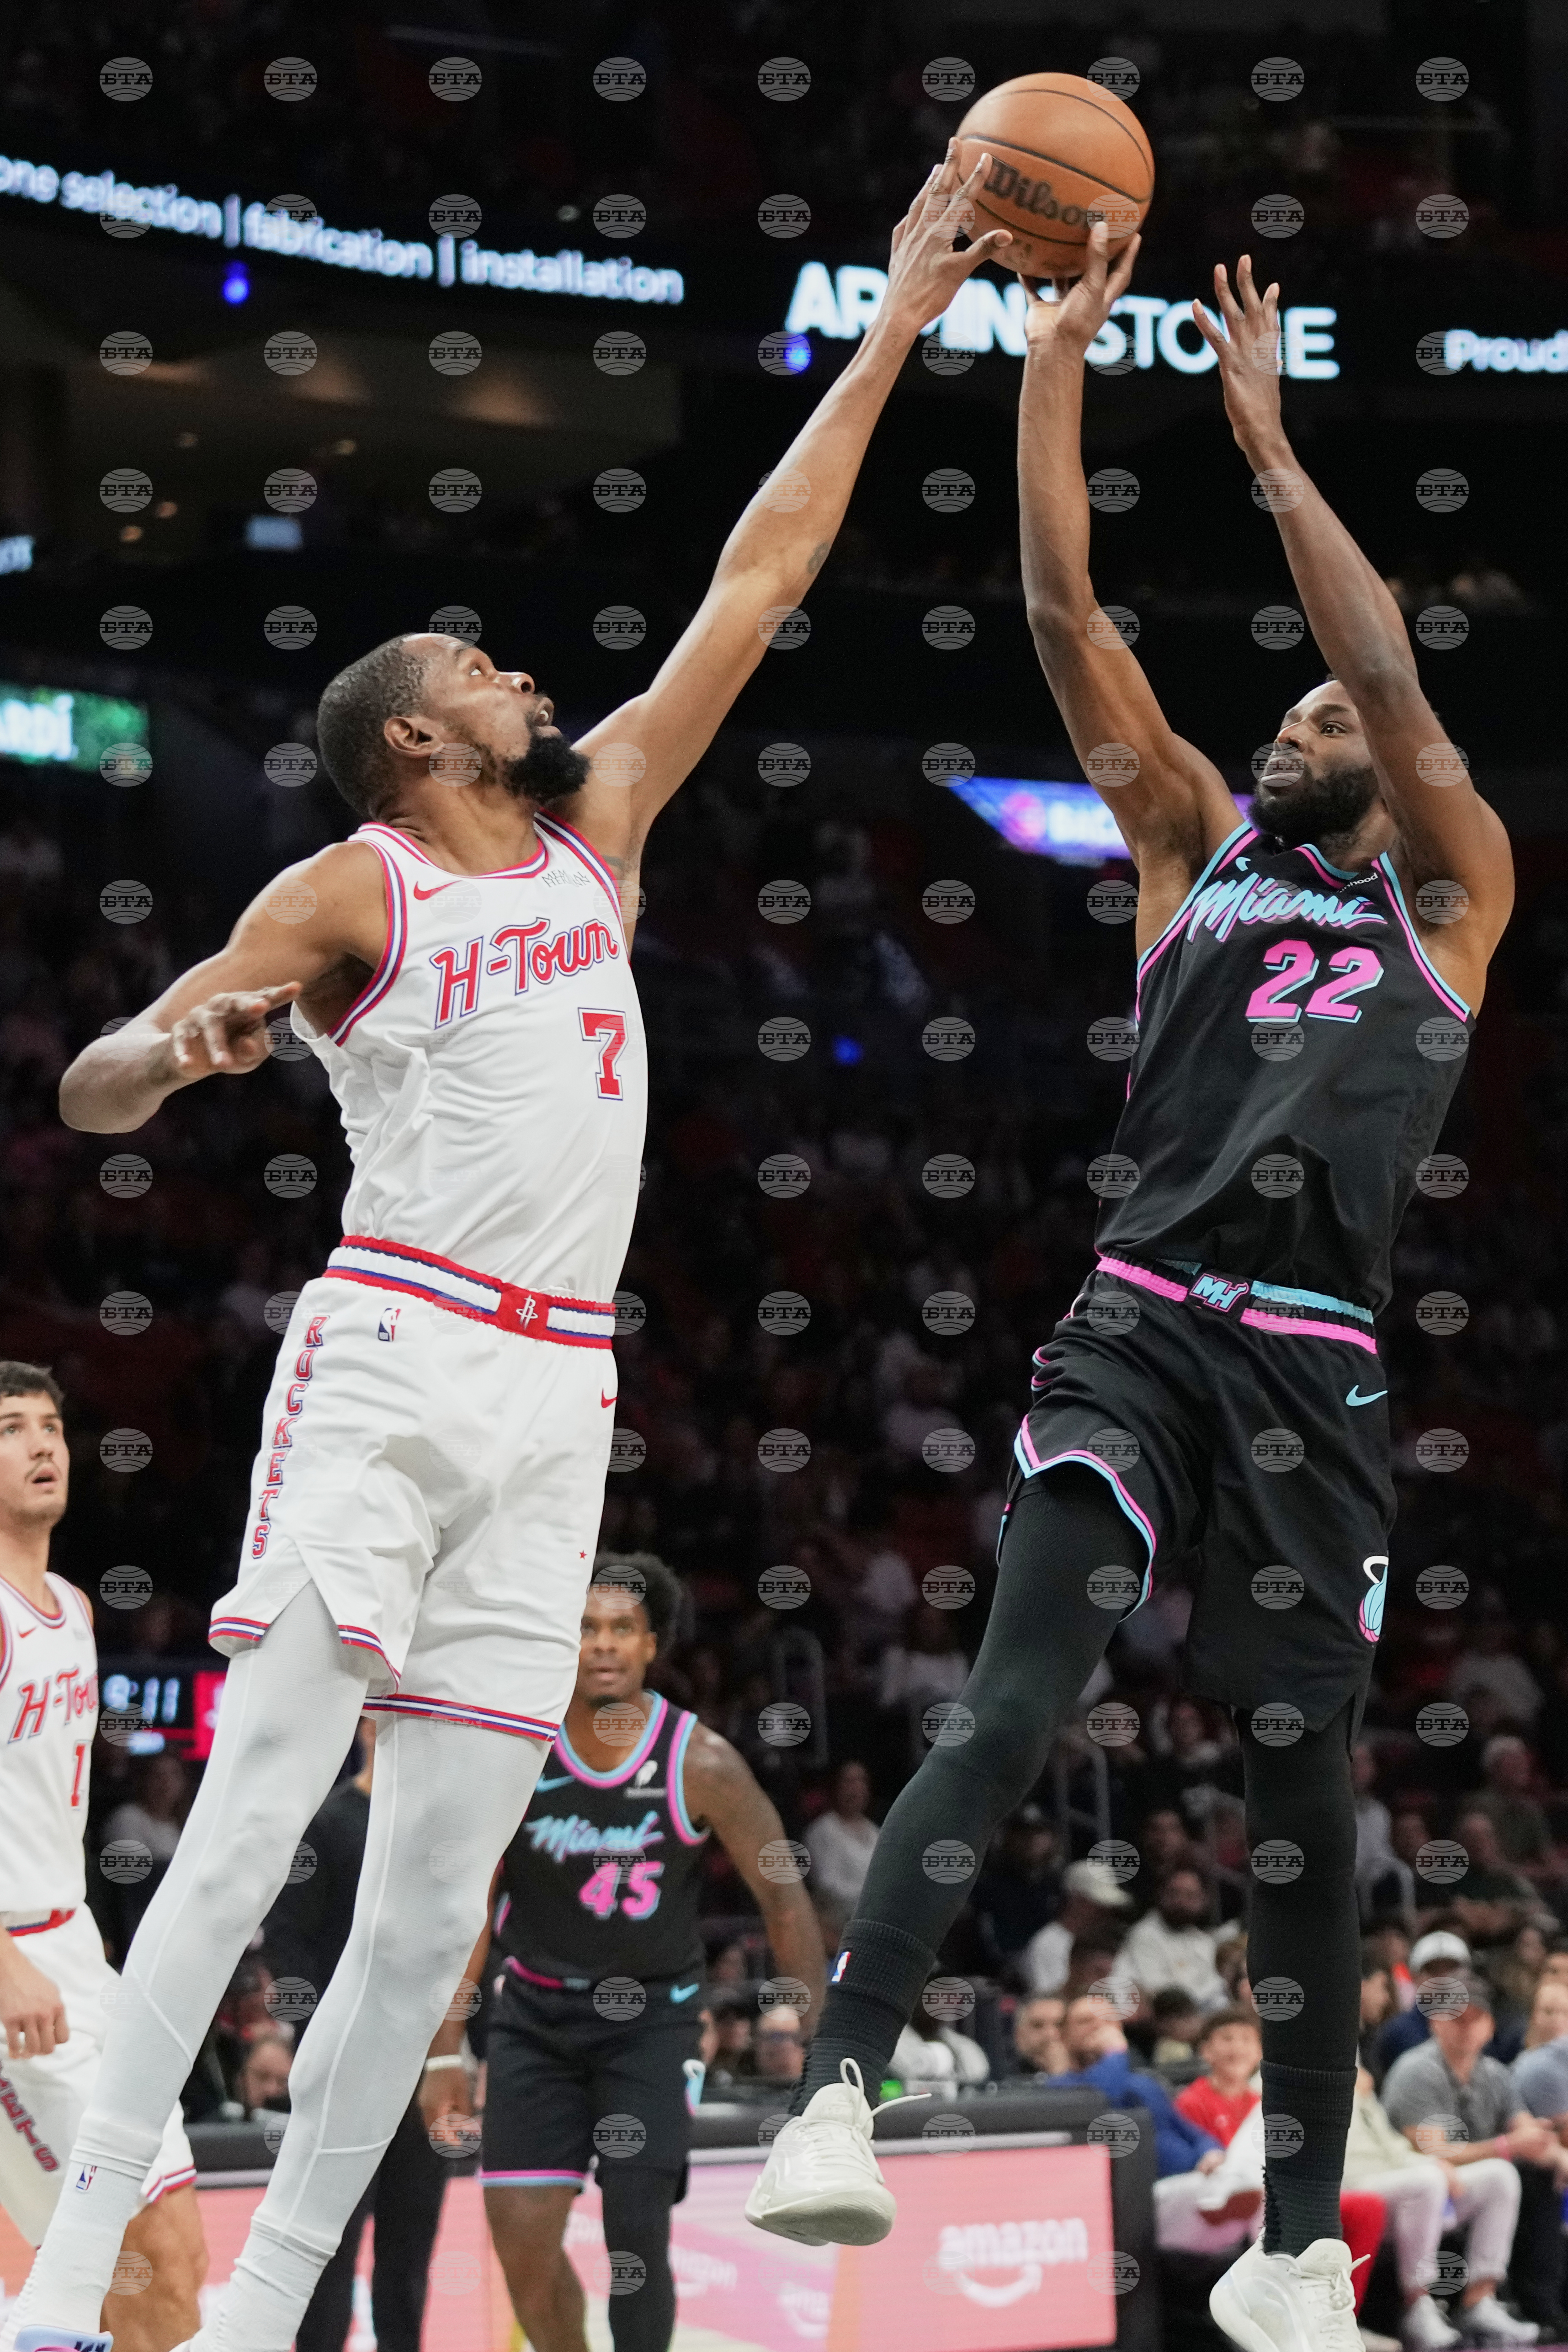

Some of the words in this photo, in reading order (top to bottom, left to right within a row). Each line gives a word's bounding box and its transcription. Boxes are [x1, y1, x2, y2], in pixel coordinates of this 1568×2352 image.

[61, 170, 223, 239] selection
[243, 202, 434, 277] fabrication
[460, 239, 685, 304] installation
[1188, 872, 1388, 942] Miami
[429, 916, 619, 1031] H-Town
[1245, 939, 1384, 1023] 22
[577, 1007, 629, 1101] 7
[251, 1314, 330, 1559] ROCKETS
[71, 1739, 91, 1810] 1
[579, 1860, 664, 1921] 45
[938, 2217, 1089, 2270] amazon
